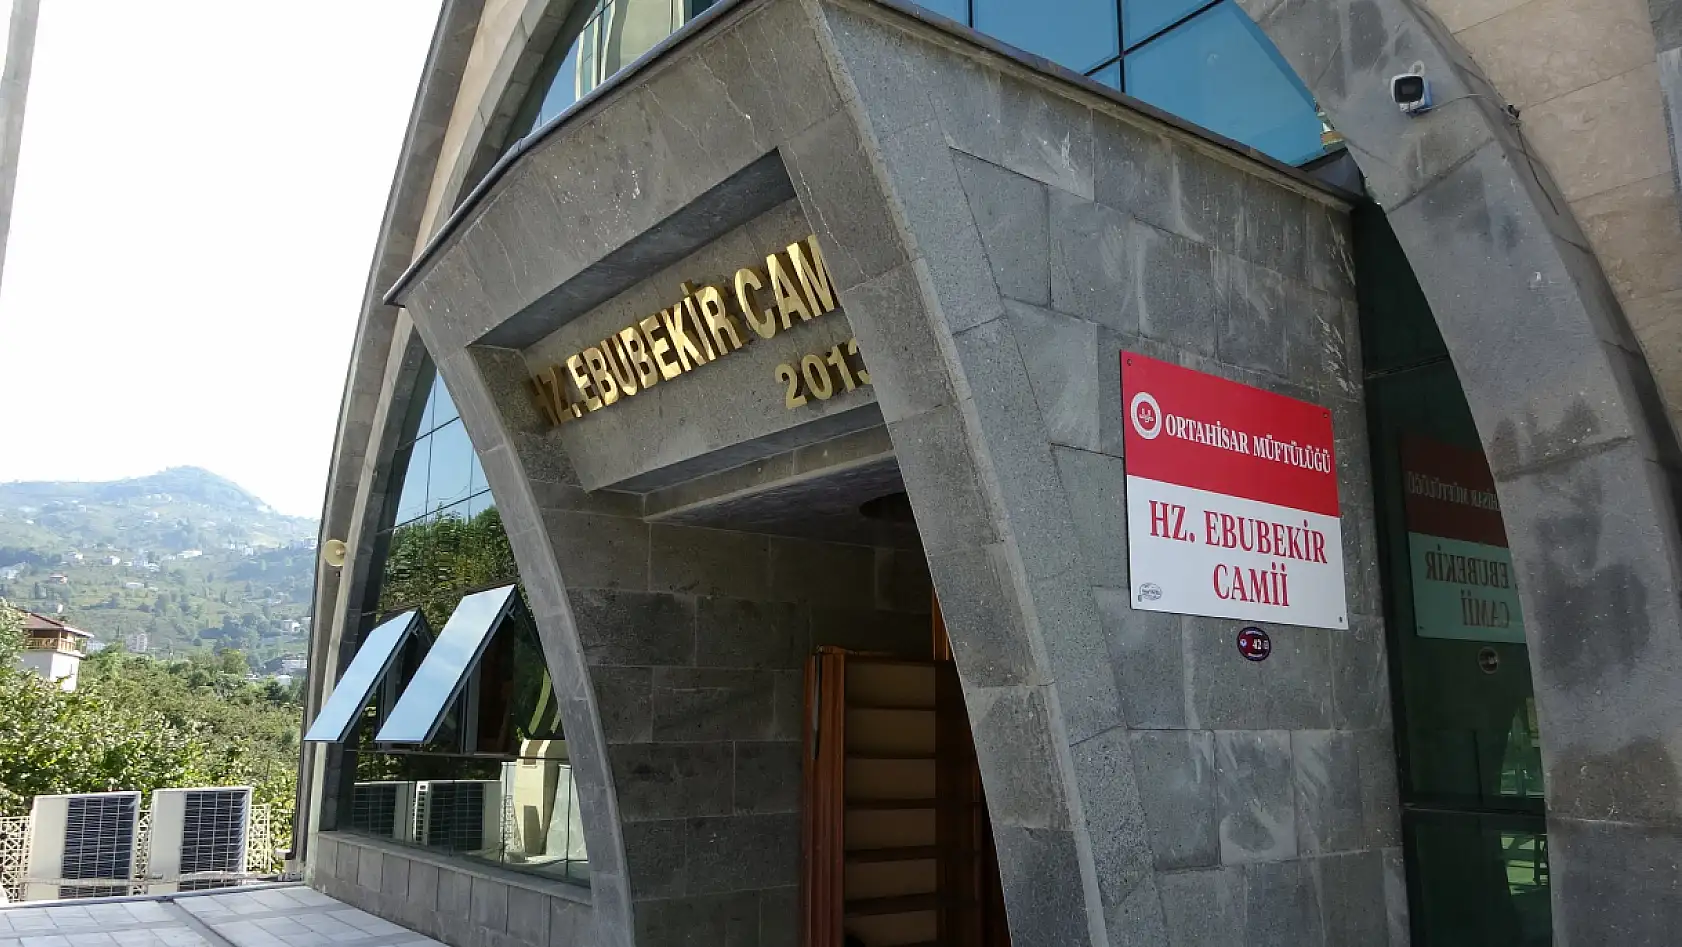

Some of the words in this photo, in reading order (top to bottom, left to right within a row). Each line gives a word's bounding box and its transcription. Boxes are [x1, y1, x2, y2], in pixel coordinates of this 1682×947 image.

[565, 279, 744, 412] EBUBEKİR
[1165, 413, 1250, 455] ORTAHİSAR
[1253, 434, 1331, 474] MÜFTÜLÜĞÜ
[1149, 500, 1196, 544] HZ.
[1203, 510, 1328, 564] EBUBEKİR
[1213, 562, 1290, 608] CAMİİ
